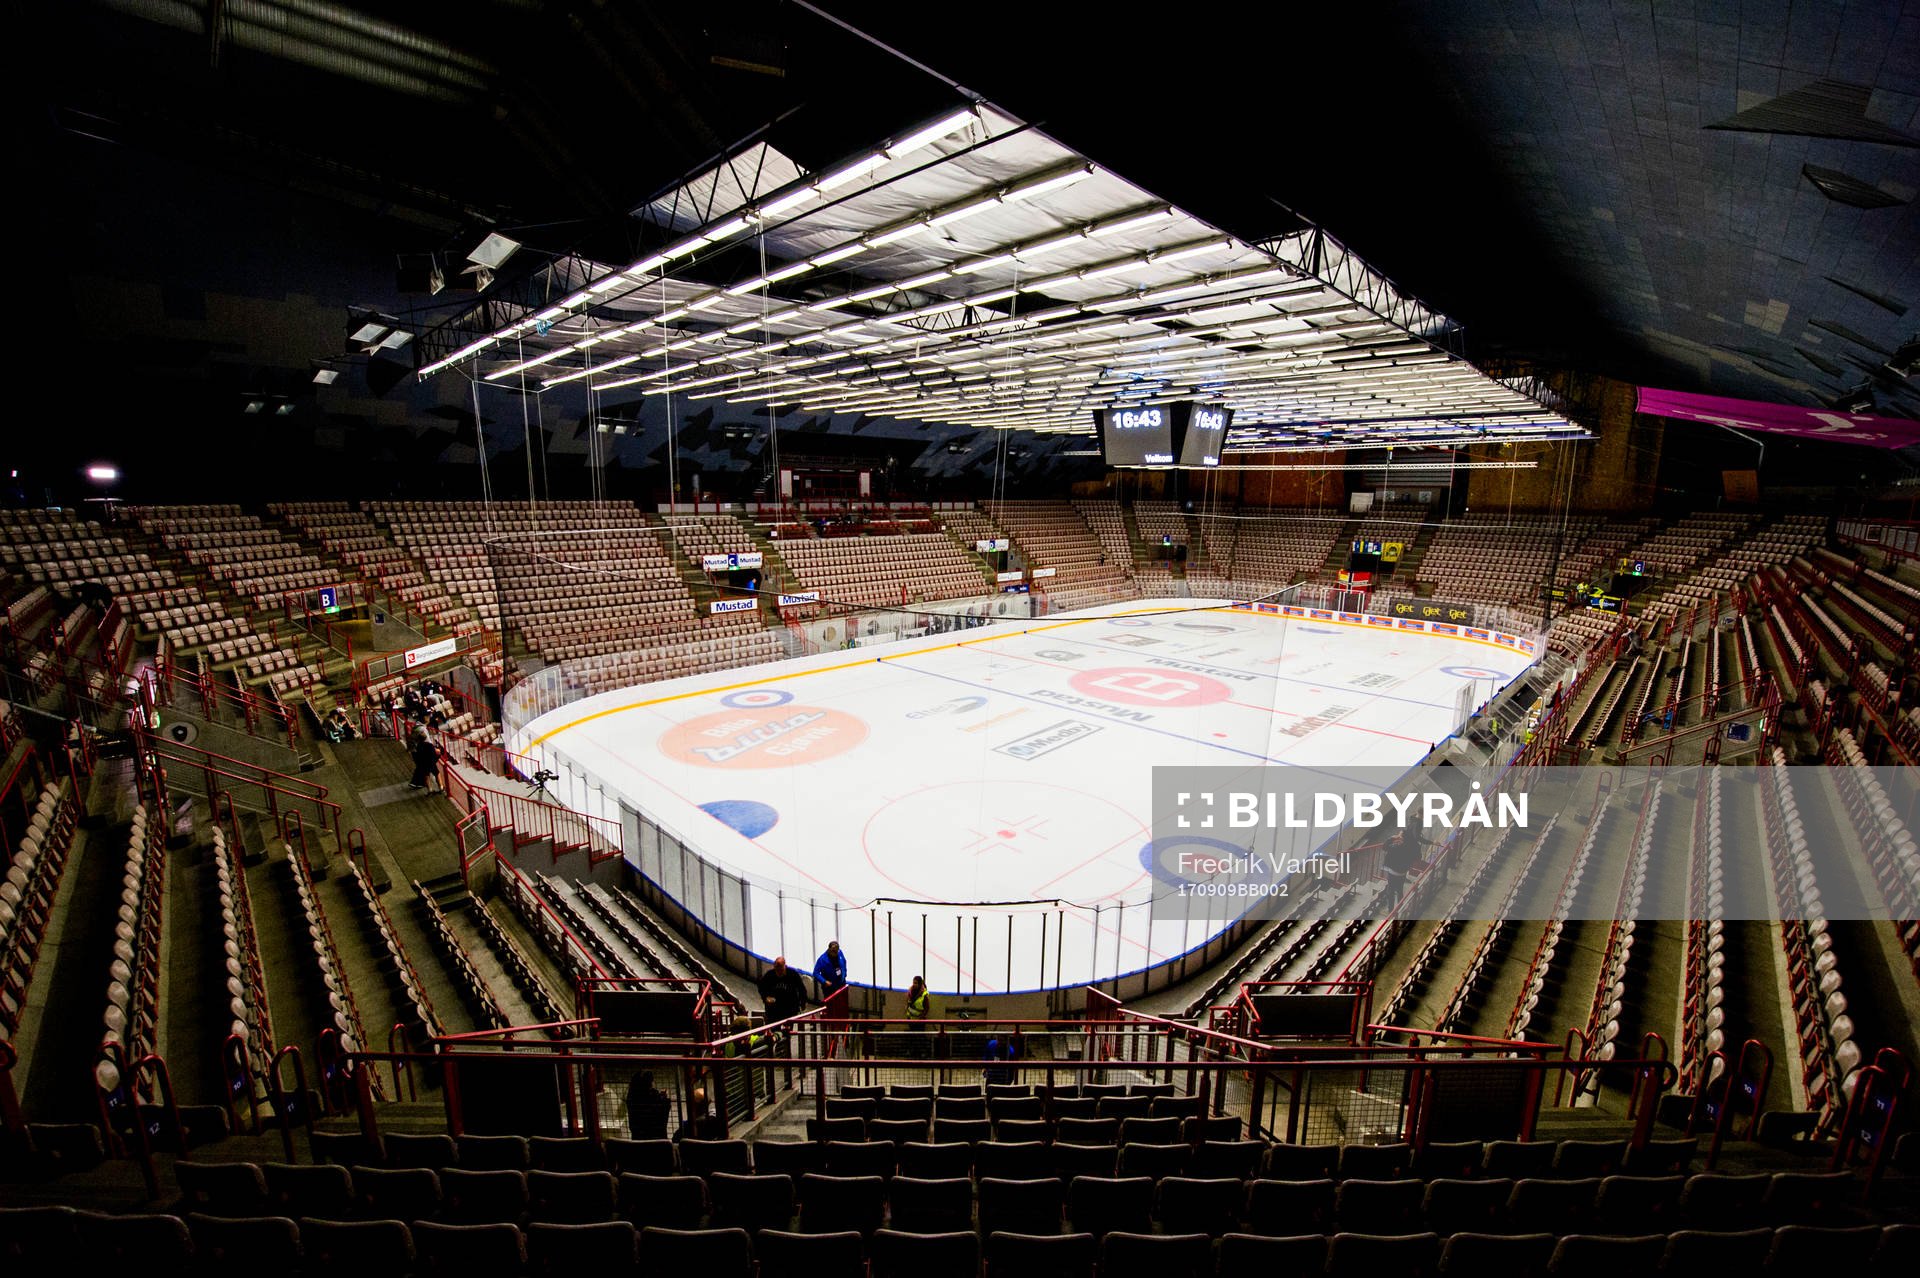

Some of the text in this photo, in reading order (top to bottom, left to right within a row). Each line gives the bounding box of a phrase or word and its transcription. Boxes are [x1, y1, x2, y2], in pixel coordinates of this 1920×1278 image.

[1112, 410, 1161, 428] 16:43
[1195, 411, 1223, 430] 16:43
[704, 558, 727, 566] Mustad
[728, 558, 735, 566] C
[740, 556, 761, 564] Mustad
[1634, 564, 1642, 572] G
[322, 594, 330, 606] B
[783, 594, 815, 605] Mustad
[716, 600, 753, 612] Mustad
[1147, 658, 1259, 682] Mustad
[1029, 689, 1156, 722] Mustad
